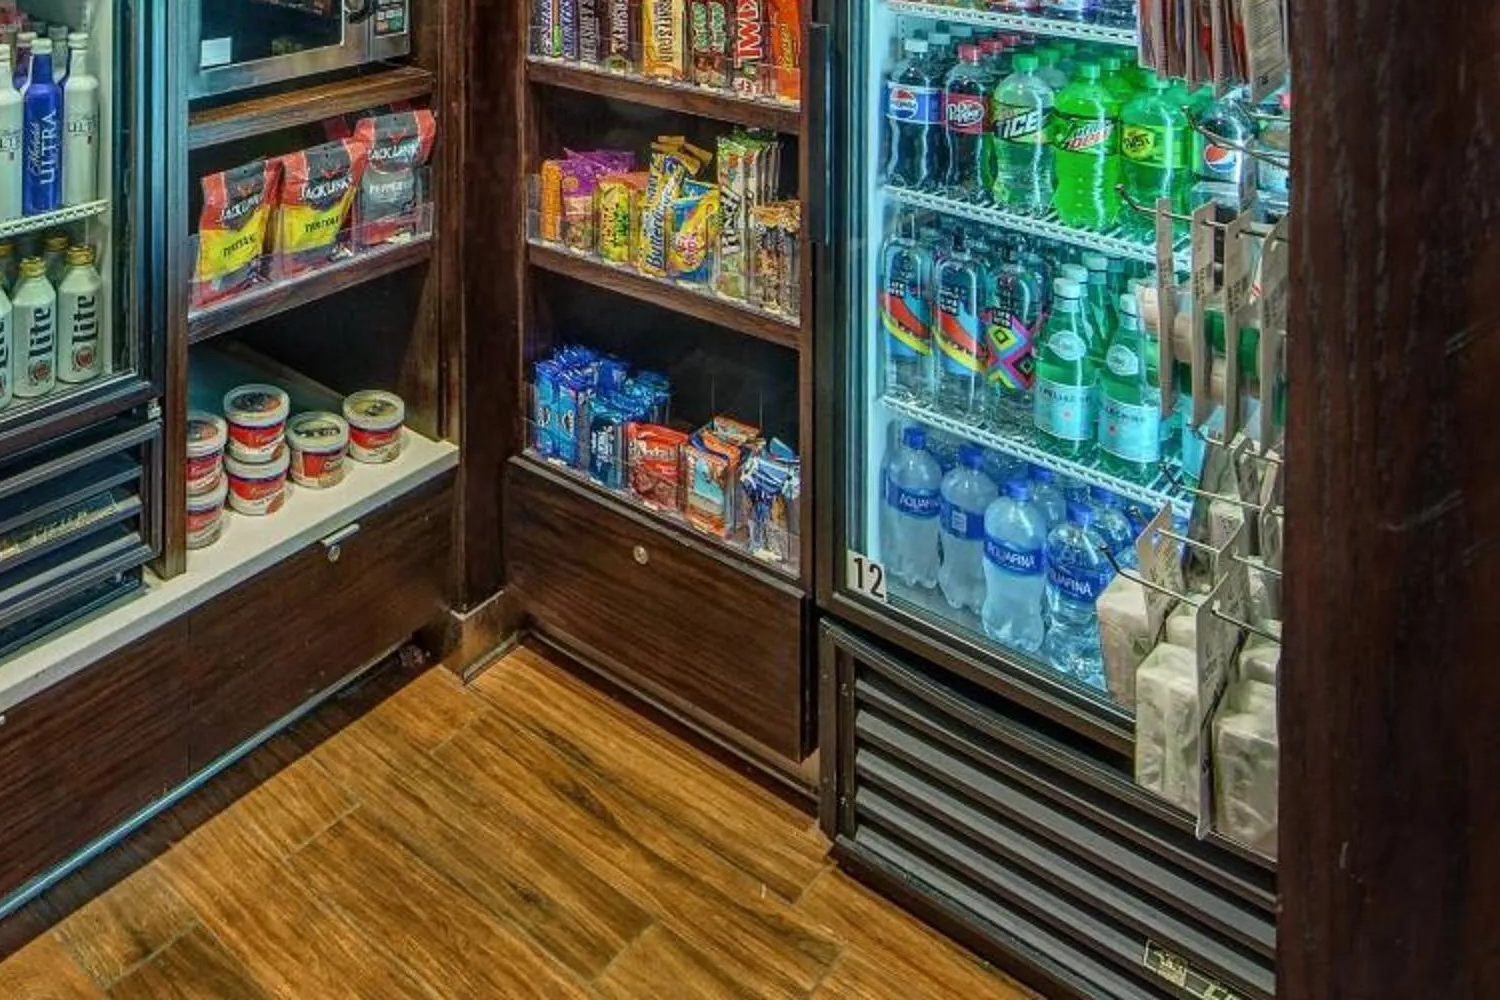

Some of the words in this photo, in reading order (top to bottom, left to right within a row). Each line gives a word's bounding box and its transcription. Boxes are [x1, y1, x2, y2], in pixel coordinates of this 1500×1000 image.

[40, 109, 57, 185] ULTRA
[1002, 112, 1040, 140] ICE
[30, 306, 54, 359] lite
[72, 294, 98, 346] lite
[852, 557, 884, 599] 12
